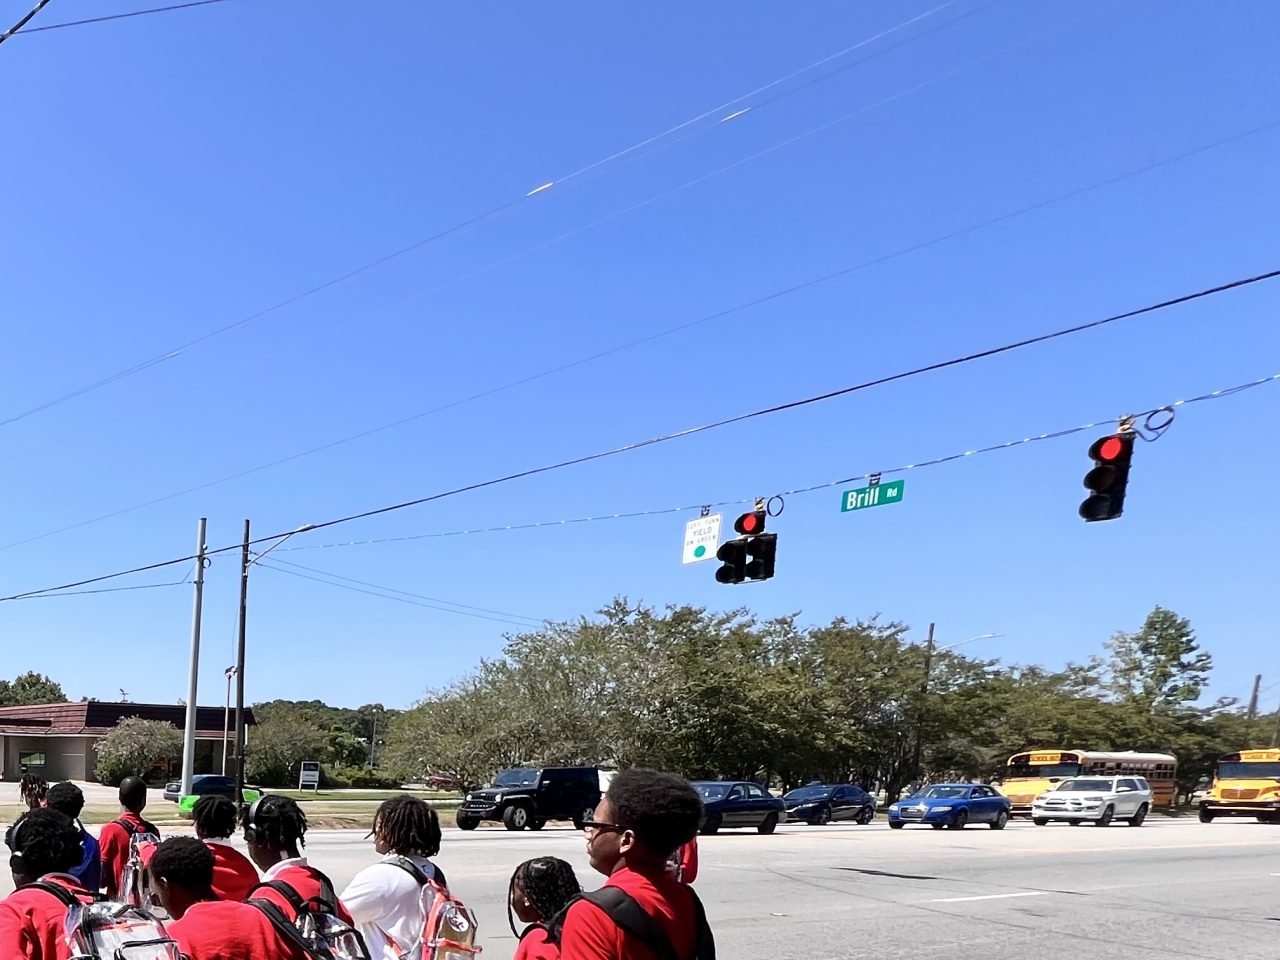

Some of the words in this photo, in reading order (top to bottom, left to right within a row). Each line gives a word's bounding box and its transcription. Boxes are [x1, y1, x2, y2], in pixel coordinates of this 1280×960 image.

[846, 486, 880, 510] Brill
[886, 487, 898, 498] Rd
[693, 526, 712, 537] YIELD
